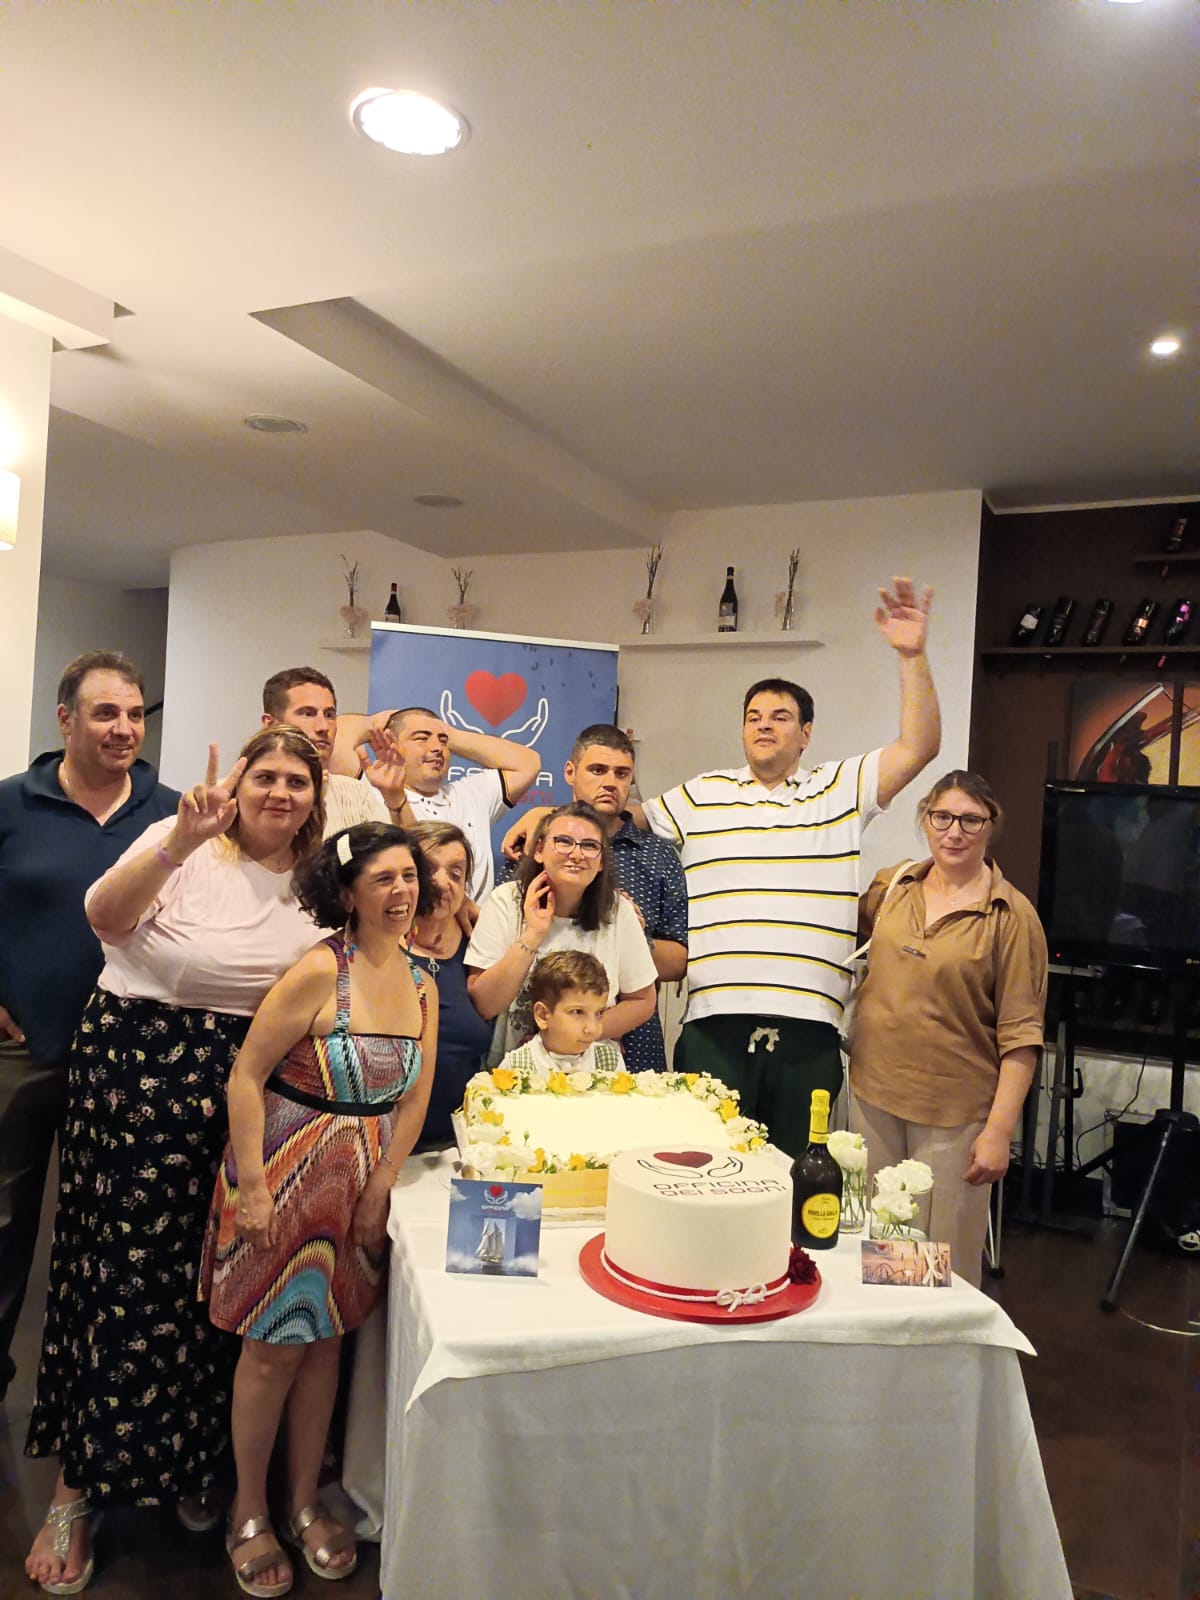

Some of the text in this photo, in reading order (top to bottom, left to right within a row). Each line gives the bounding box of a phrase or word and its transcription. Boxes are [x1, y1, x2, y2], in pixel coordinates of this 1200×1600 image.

[653, 1179, 780, 1190] OFFICINA
[660, 1185, 788, 1197] DEI SOGNI
